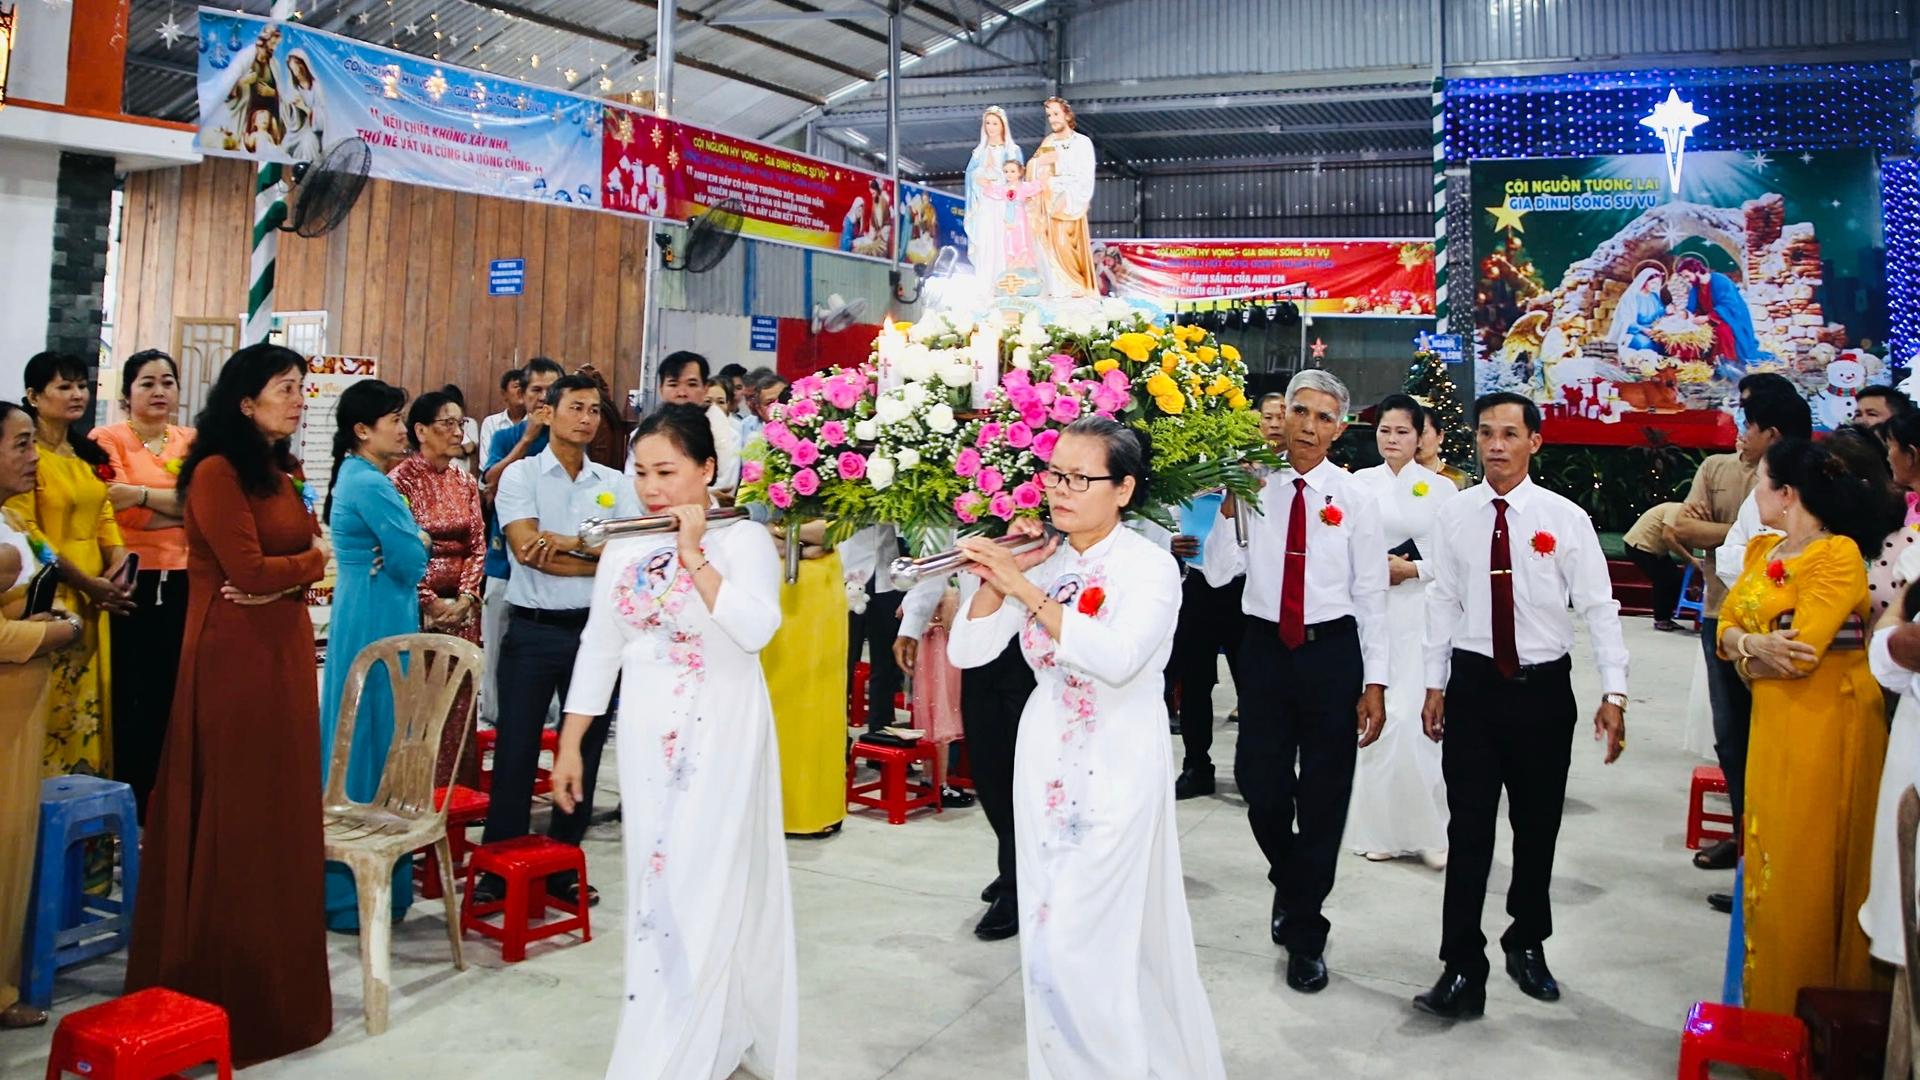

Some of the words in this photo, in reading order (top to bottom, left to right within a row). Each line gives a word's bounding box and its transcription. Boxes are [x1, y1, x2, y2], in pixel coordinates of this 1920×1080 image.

[1505, 178, 1528, 196] CỘI
[1532, 175, 1581, 193] NGUỒN
[1637, 178, 1660, 191] LAI
[1509, 196, 1532, 210] GIA
[1242, 248, 1256, 257] GIA
